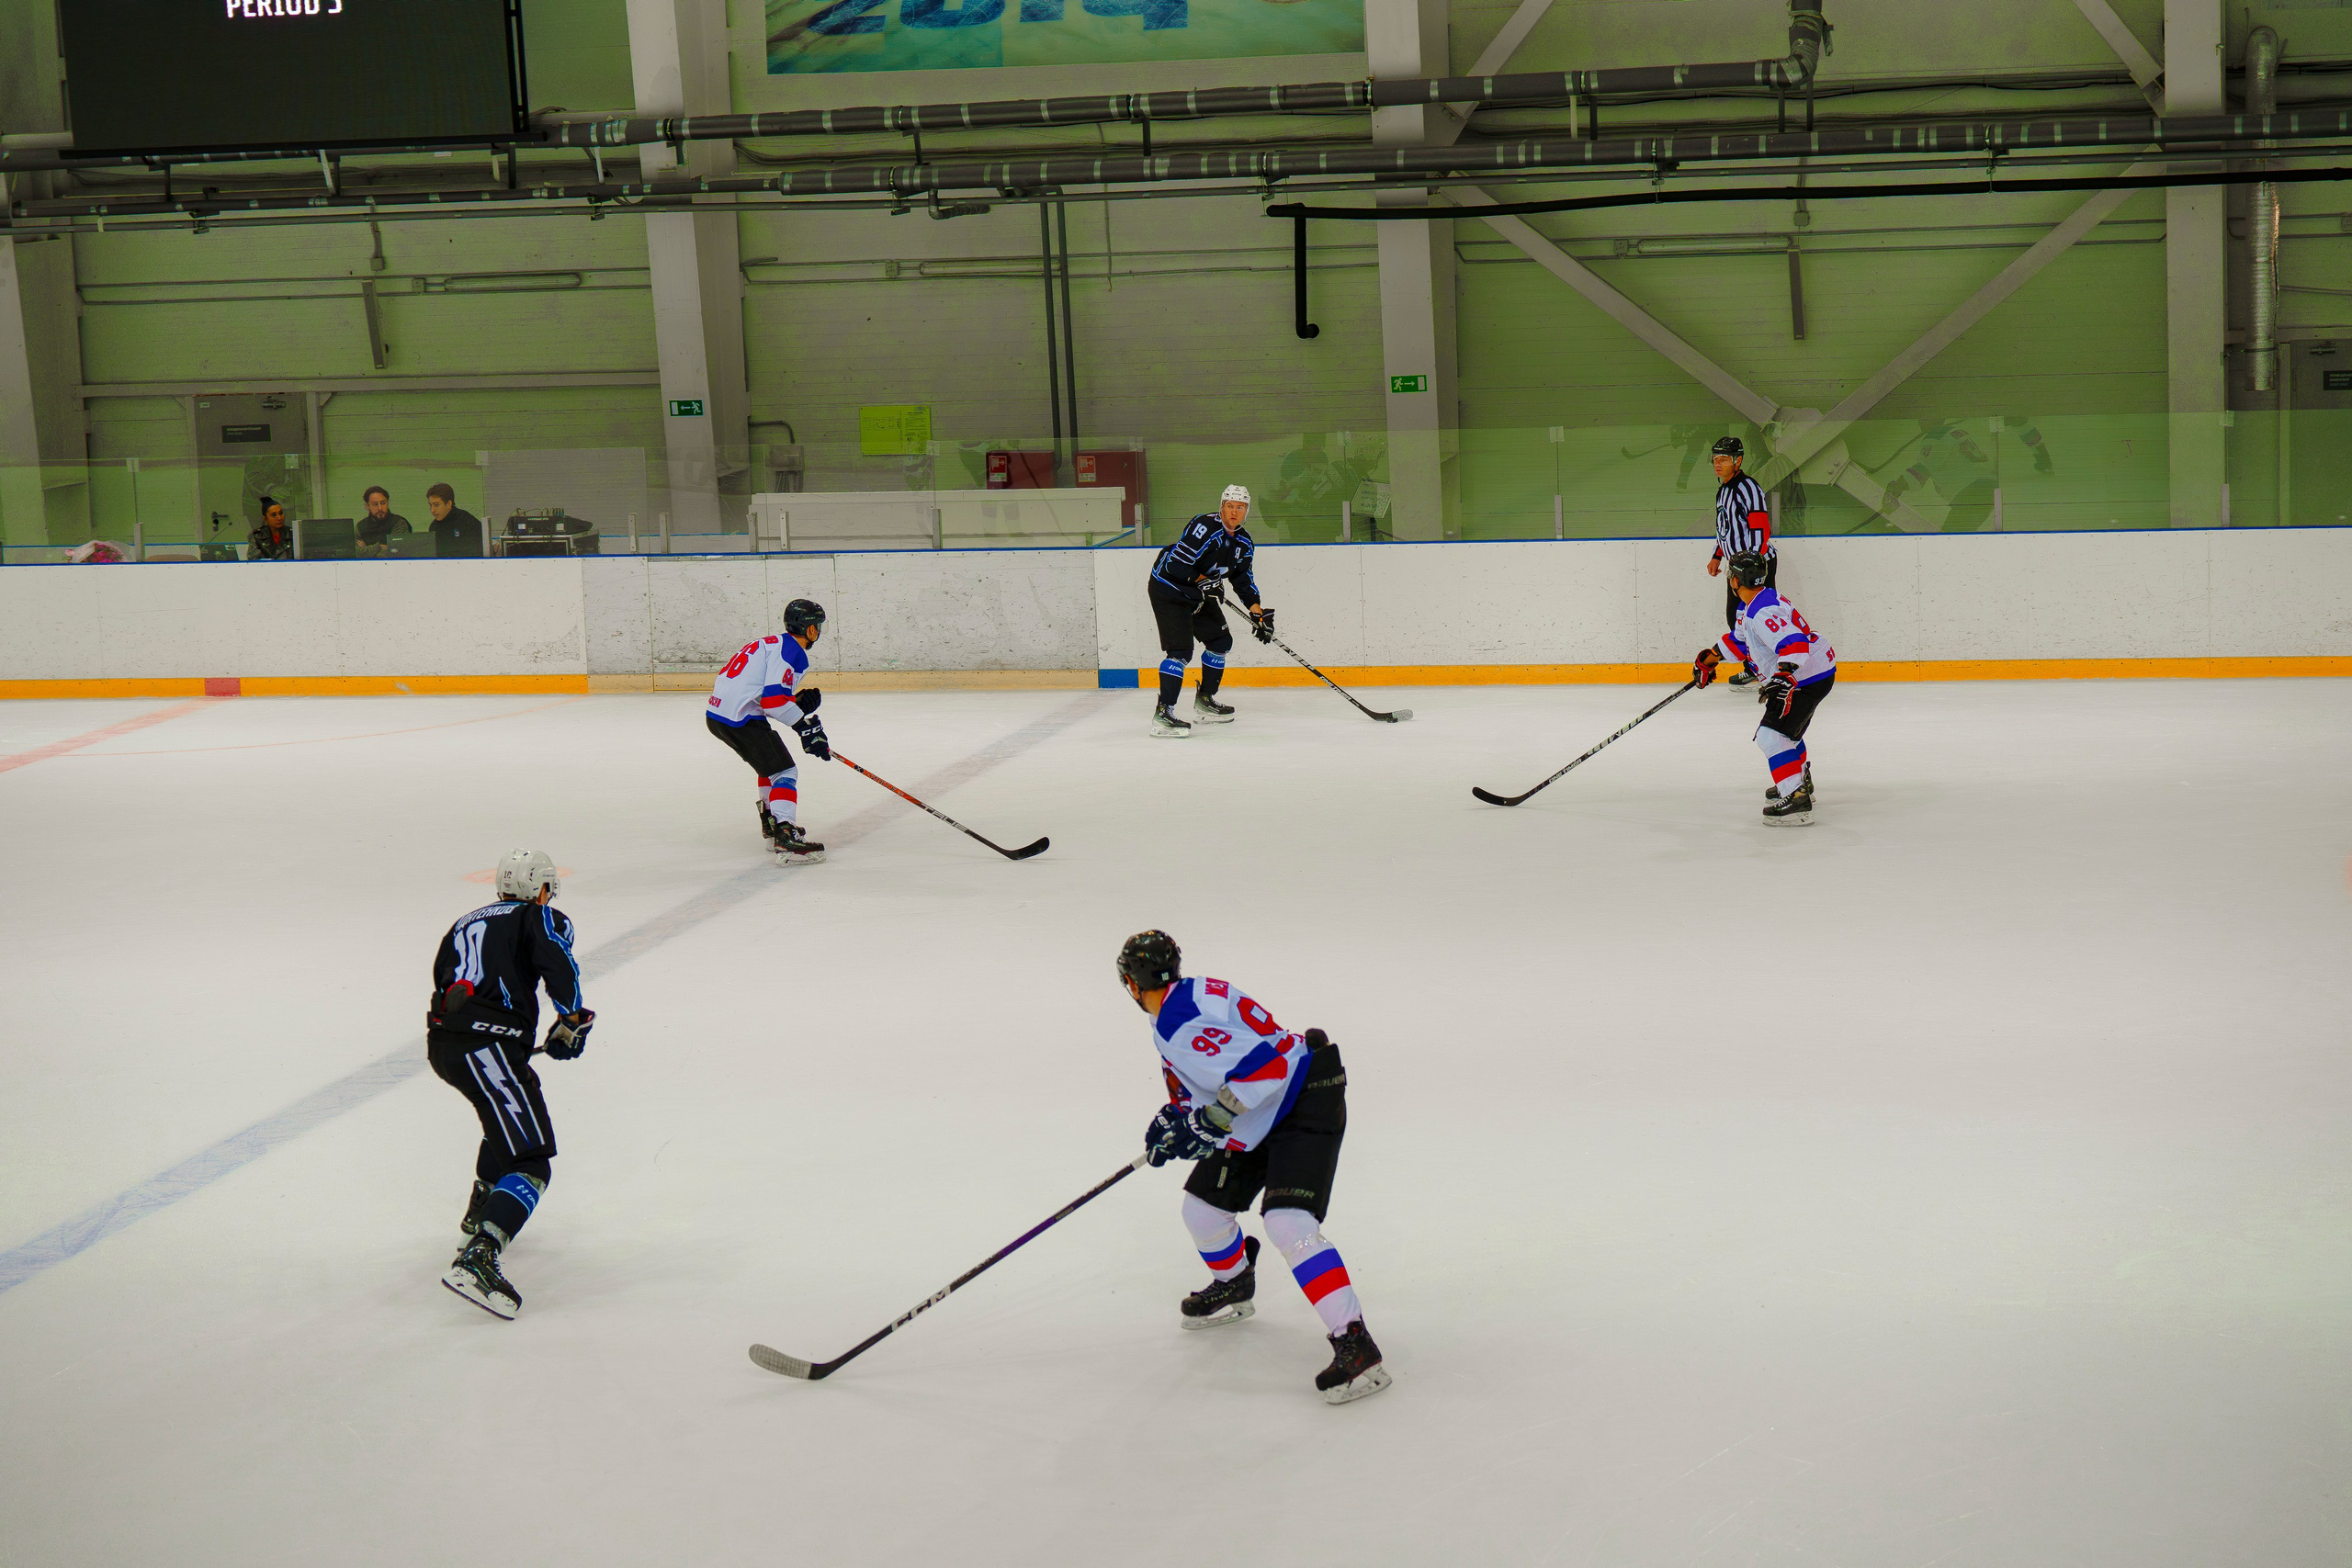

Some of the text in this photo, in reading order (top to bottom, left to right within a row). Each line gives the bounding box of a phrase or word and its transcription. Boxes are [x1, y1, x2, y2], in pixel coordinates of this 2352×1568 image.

[225, 0, 320, 17] PERIOD
[1192, 523, 1208, 539] 19
[453, 919, 488, 987] 10
[471, 1021, 523, 1038] CCM
[1191, 1027, 1232, 1056] 99
[890, 1285, 952, 1332] CCM
